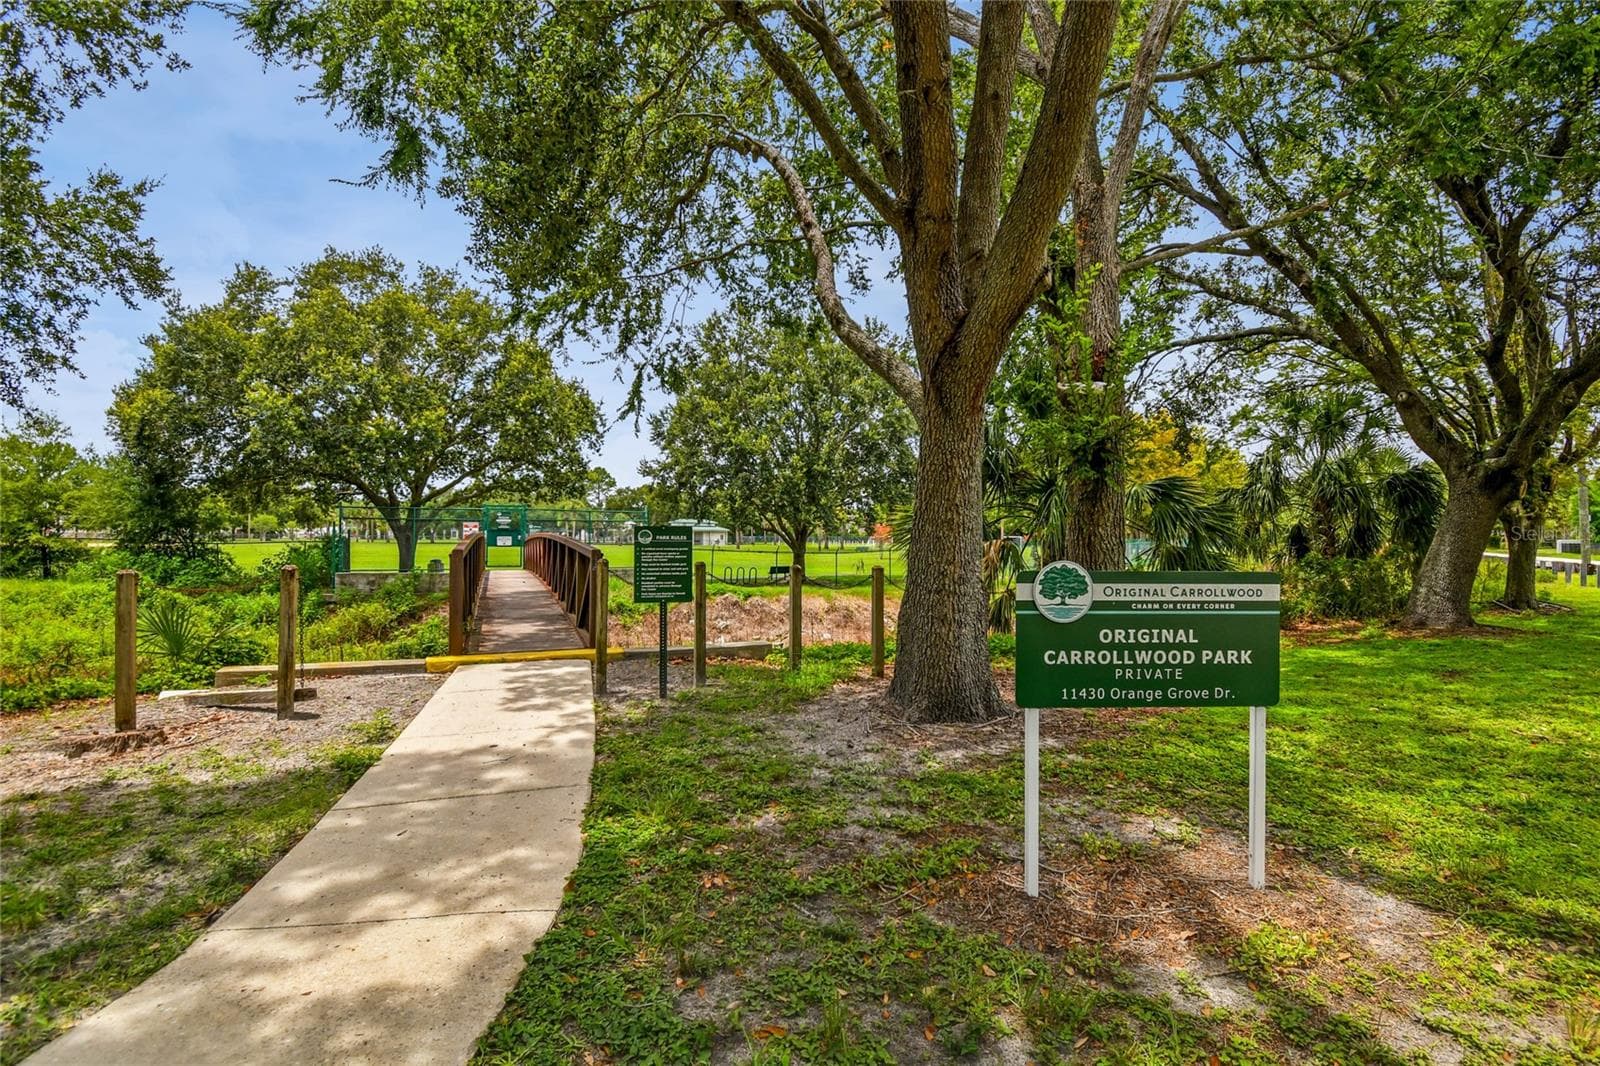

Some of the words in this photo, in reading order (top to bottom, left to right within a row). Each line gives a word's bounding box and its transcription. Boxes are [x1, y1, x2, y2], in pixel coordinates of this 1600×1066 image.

[1099, 628, 1199, 644] ORIGINAL
[1043, 650, 1196, 665] CARROLLWOOD
[1201, 650, 1253, 664] PARK
[1114, 668, 1183, 680] PRIVATE
[1061, 687, 1105, 700] 11430
[1110, 687, 1163, 702] Orange
[1167, 687, 1209, 700] Grove
[1214, 687, 1236, 699] Dr.
